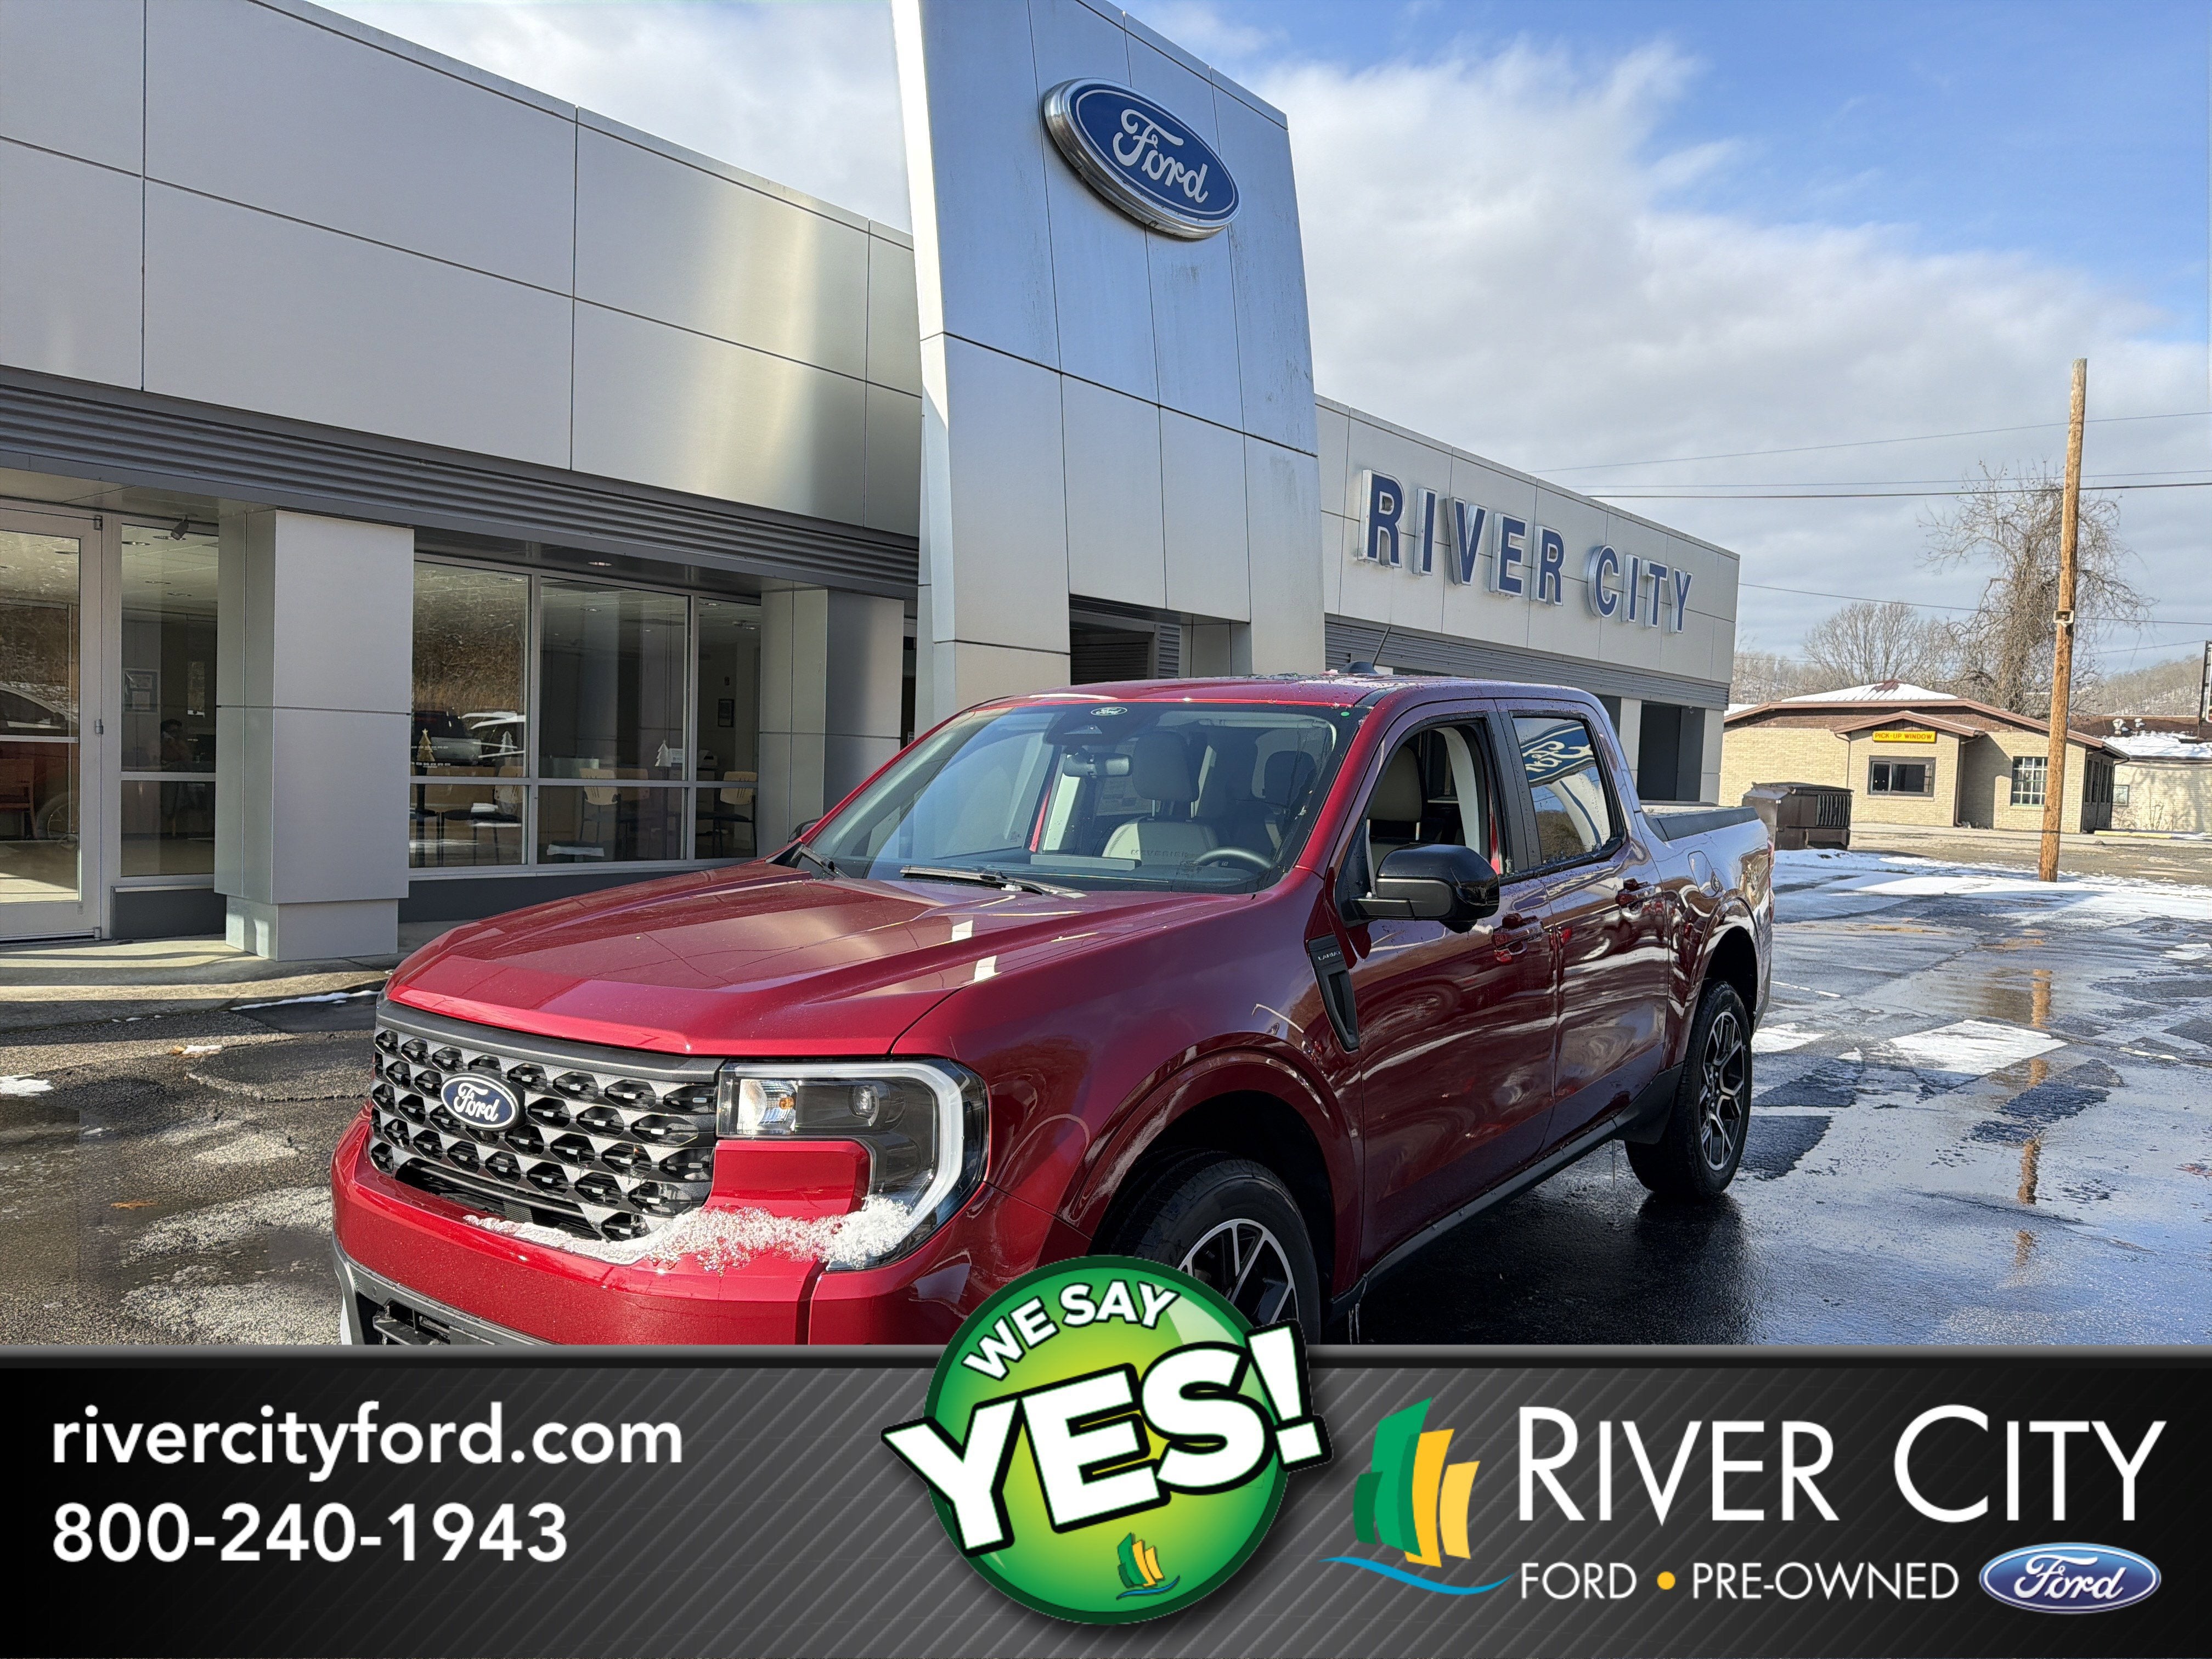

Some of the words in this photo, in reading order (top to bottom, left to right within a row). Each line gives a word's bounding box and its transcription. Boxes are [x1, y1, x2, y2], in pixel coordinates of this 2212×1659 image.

[1113, 109, 1208, 203] Ford
[1357, 469, 1566, 606] RIVER
[1587, 545, 1694, 634] CITY
[453, 1082, 500, 1122] Ford
